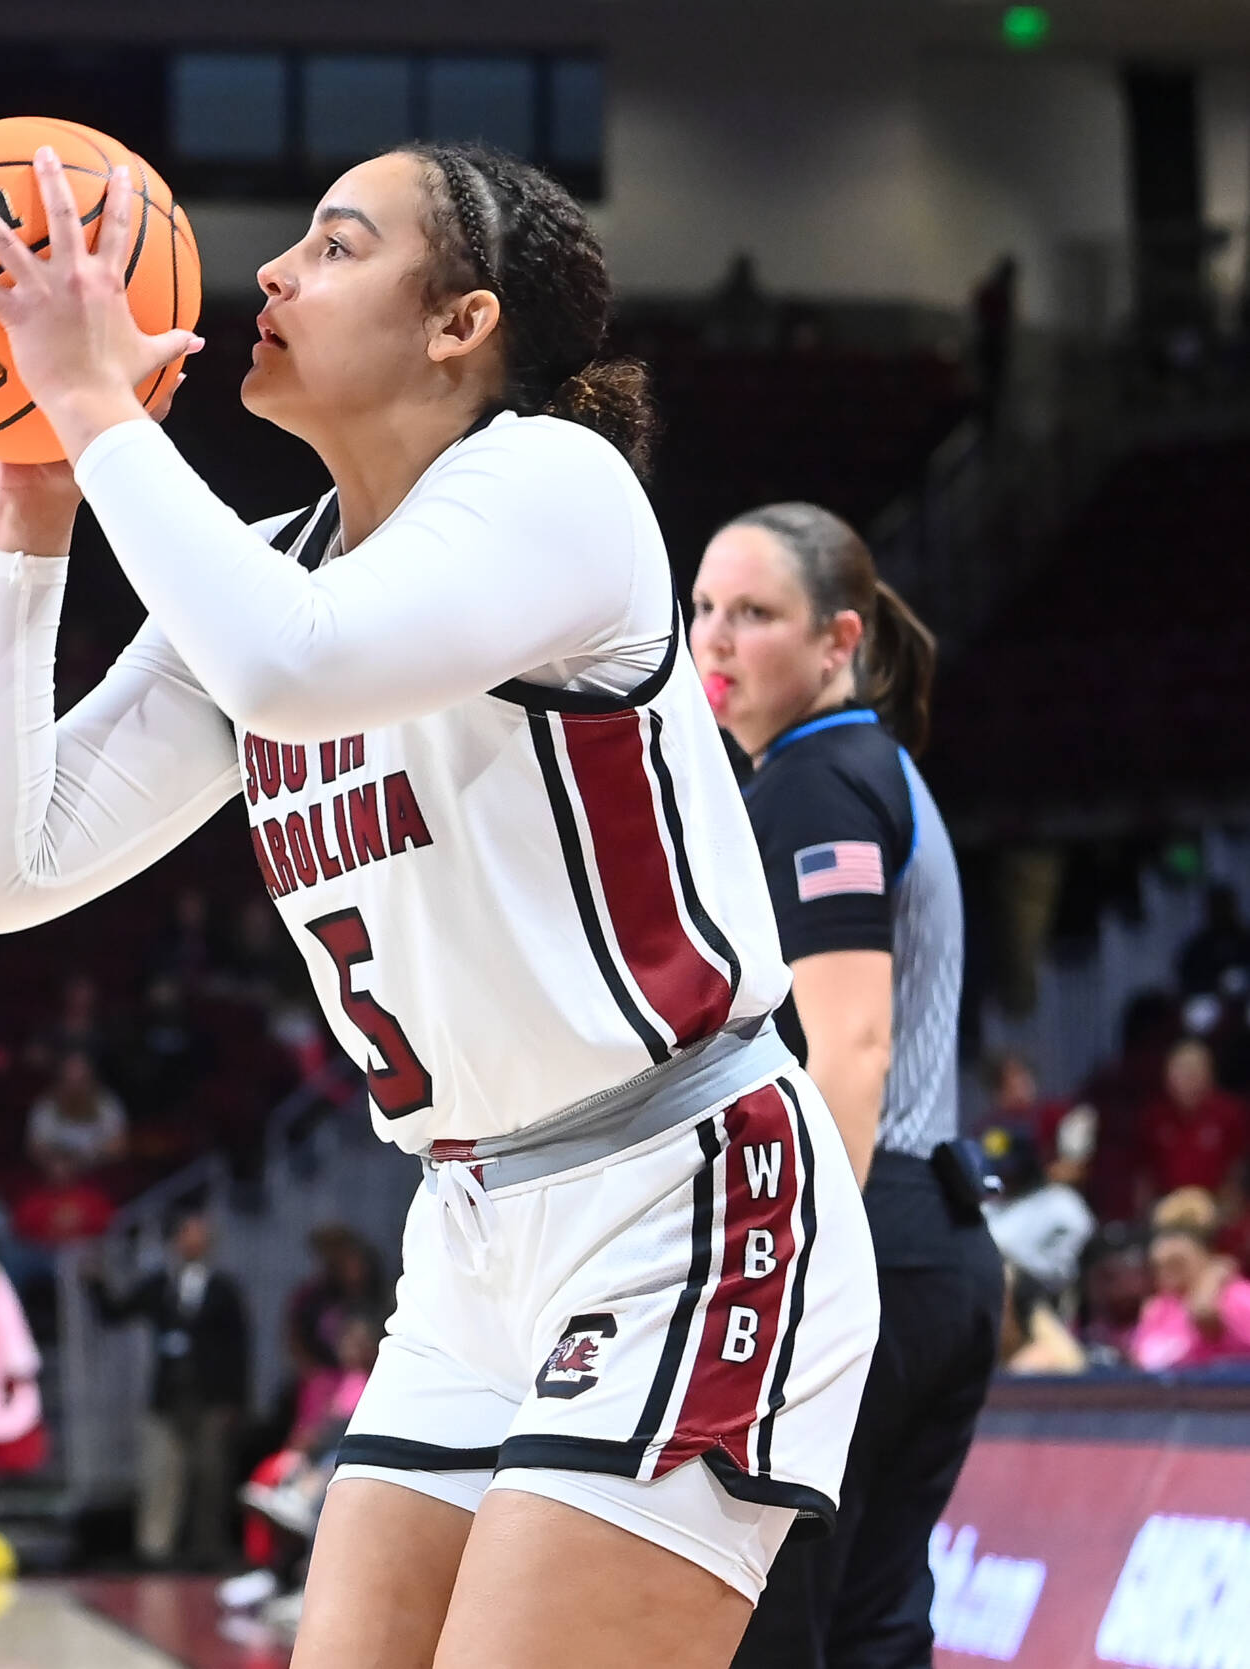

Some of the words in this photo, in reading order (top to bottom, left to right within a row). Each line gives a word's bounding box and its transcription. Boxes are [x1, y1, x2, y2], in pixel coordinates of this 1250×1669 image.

[244, 731, 365, 806] SOUTH
[250, 770, 434, 901] AROLINA
[304, 906, 434, 1120] 5
